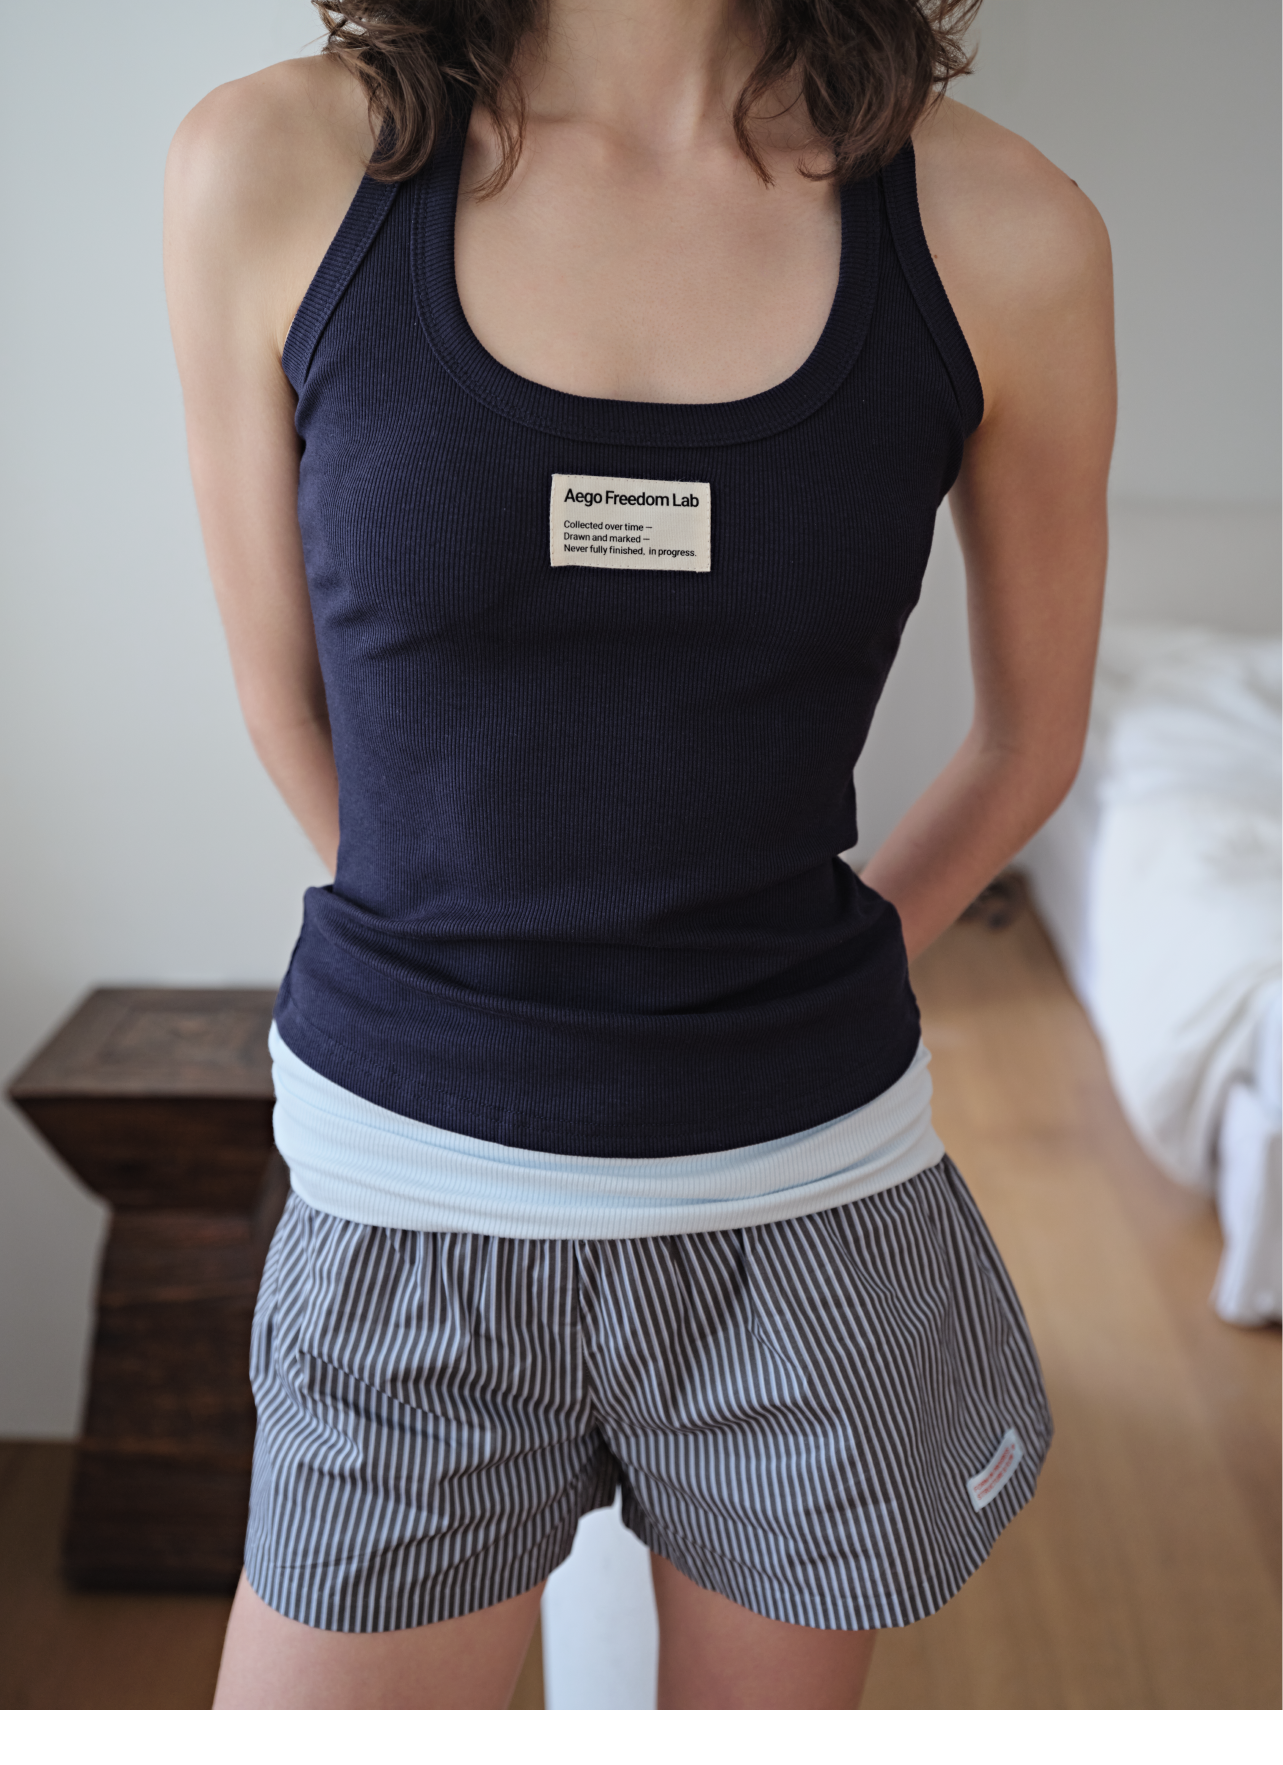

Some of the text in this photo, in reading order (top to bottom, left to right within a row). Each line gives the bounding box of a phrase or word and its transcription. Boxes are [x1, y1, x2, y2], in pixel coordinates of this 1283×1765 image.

[564, 489, 699, 507] Aego Freedom Lab
[564, 520, 603, 529] Collected
[625, 523, 643, 531] time
[564, 532, 640, 542] Drawn and marked
[564, 544, 588, 553] Never
[590, 545, 607, 555] fully
[658, 549, 697, 558] progress.
